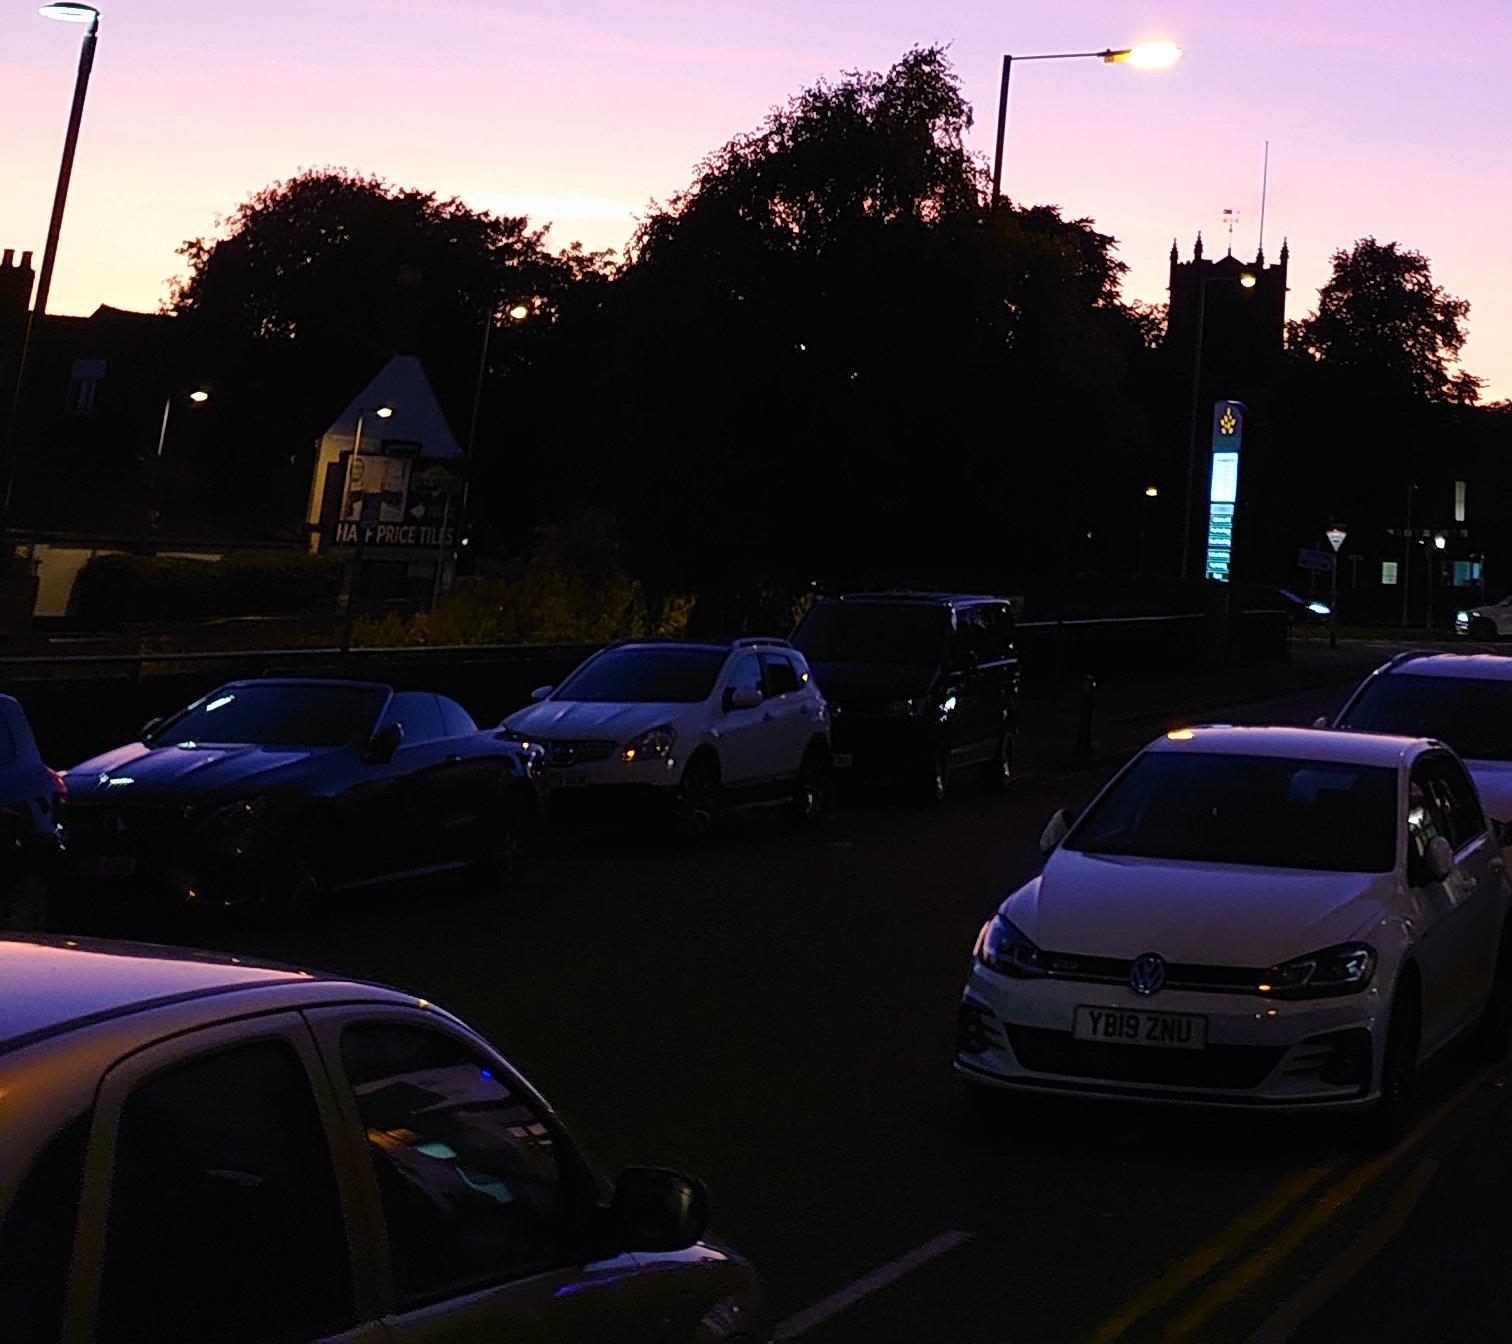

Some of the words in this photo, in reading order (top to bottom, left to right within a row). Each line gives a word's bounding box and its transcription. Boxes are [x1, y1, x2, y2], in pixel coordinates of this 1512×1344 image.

[335, 522, 374, 544] HAF
[375, 524, 416, 545] PRICE
[1088, 1010, 1139, 1039] YB19
[1145, 1015, 1192, 1043] ZNU
